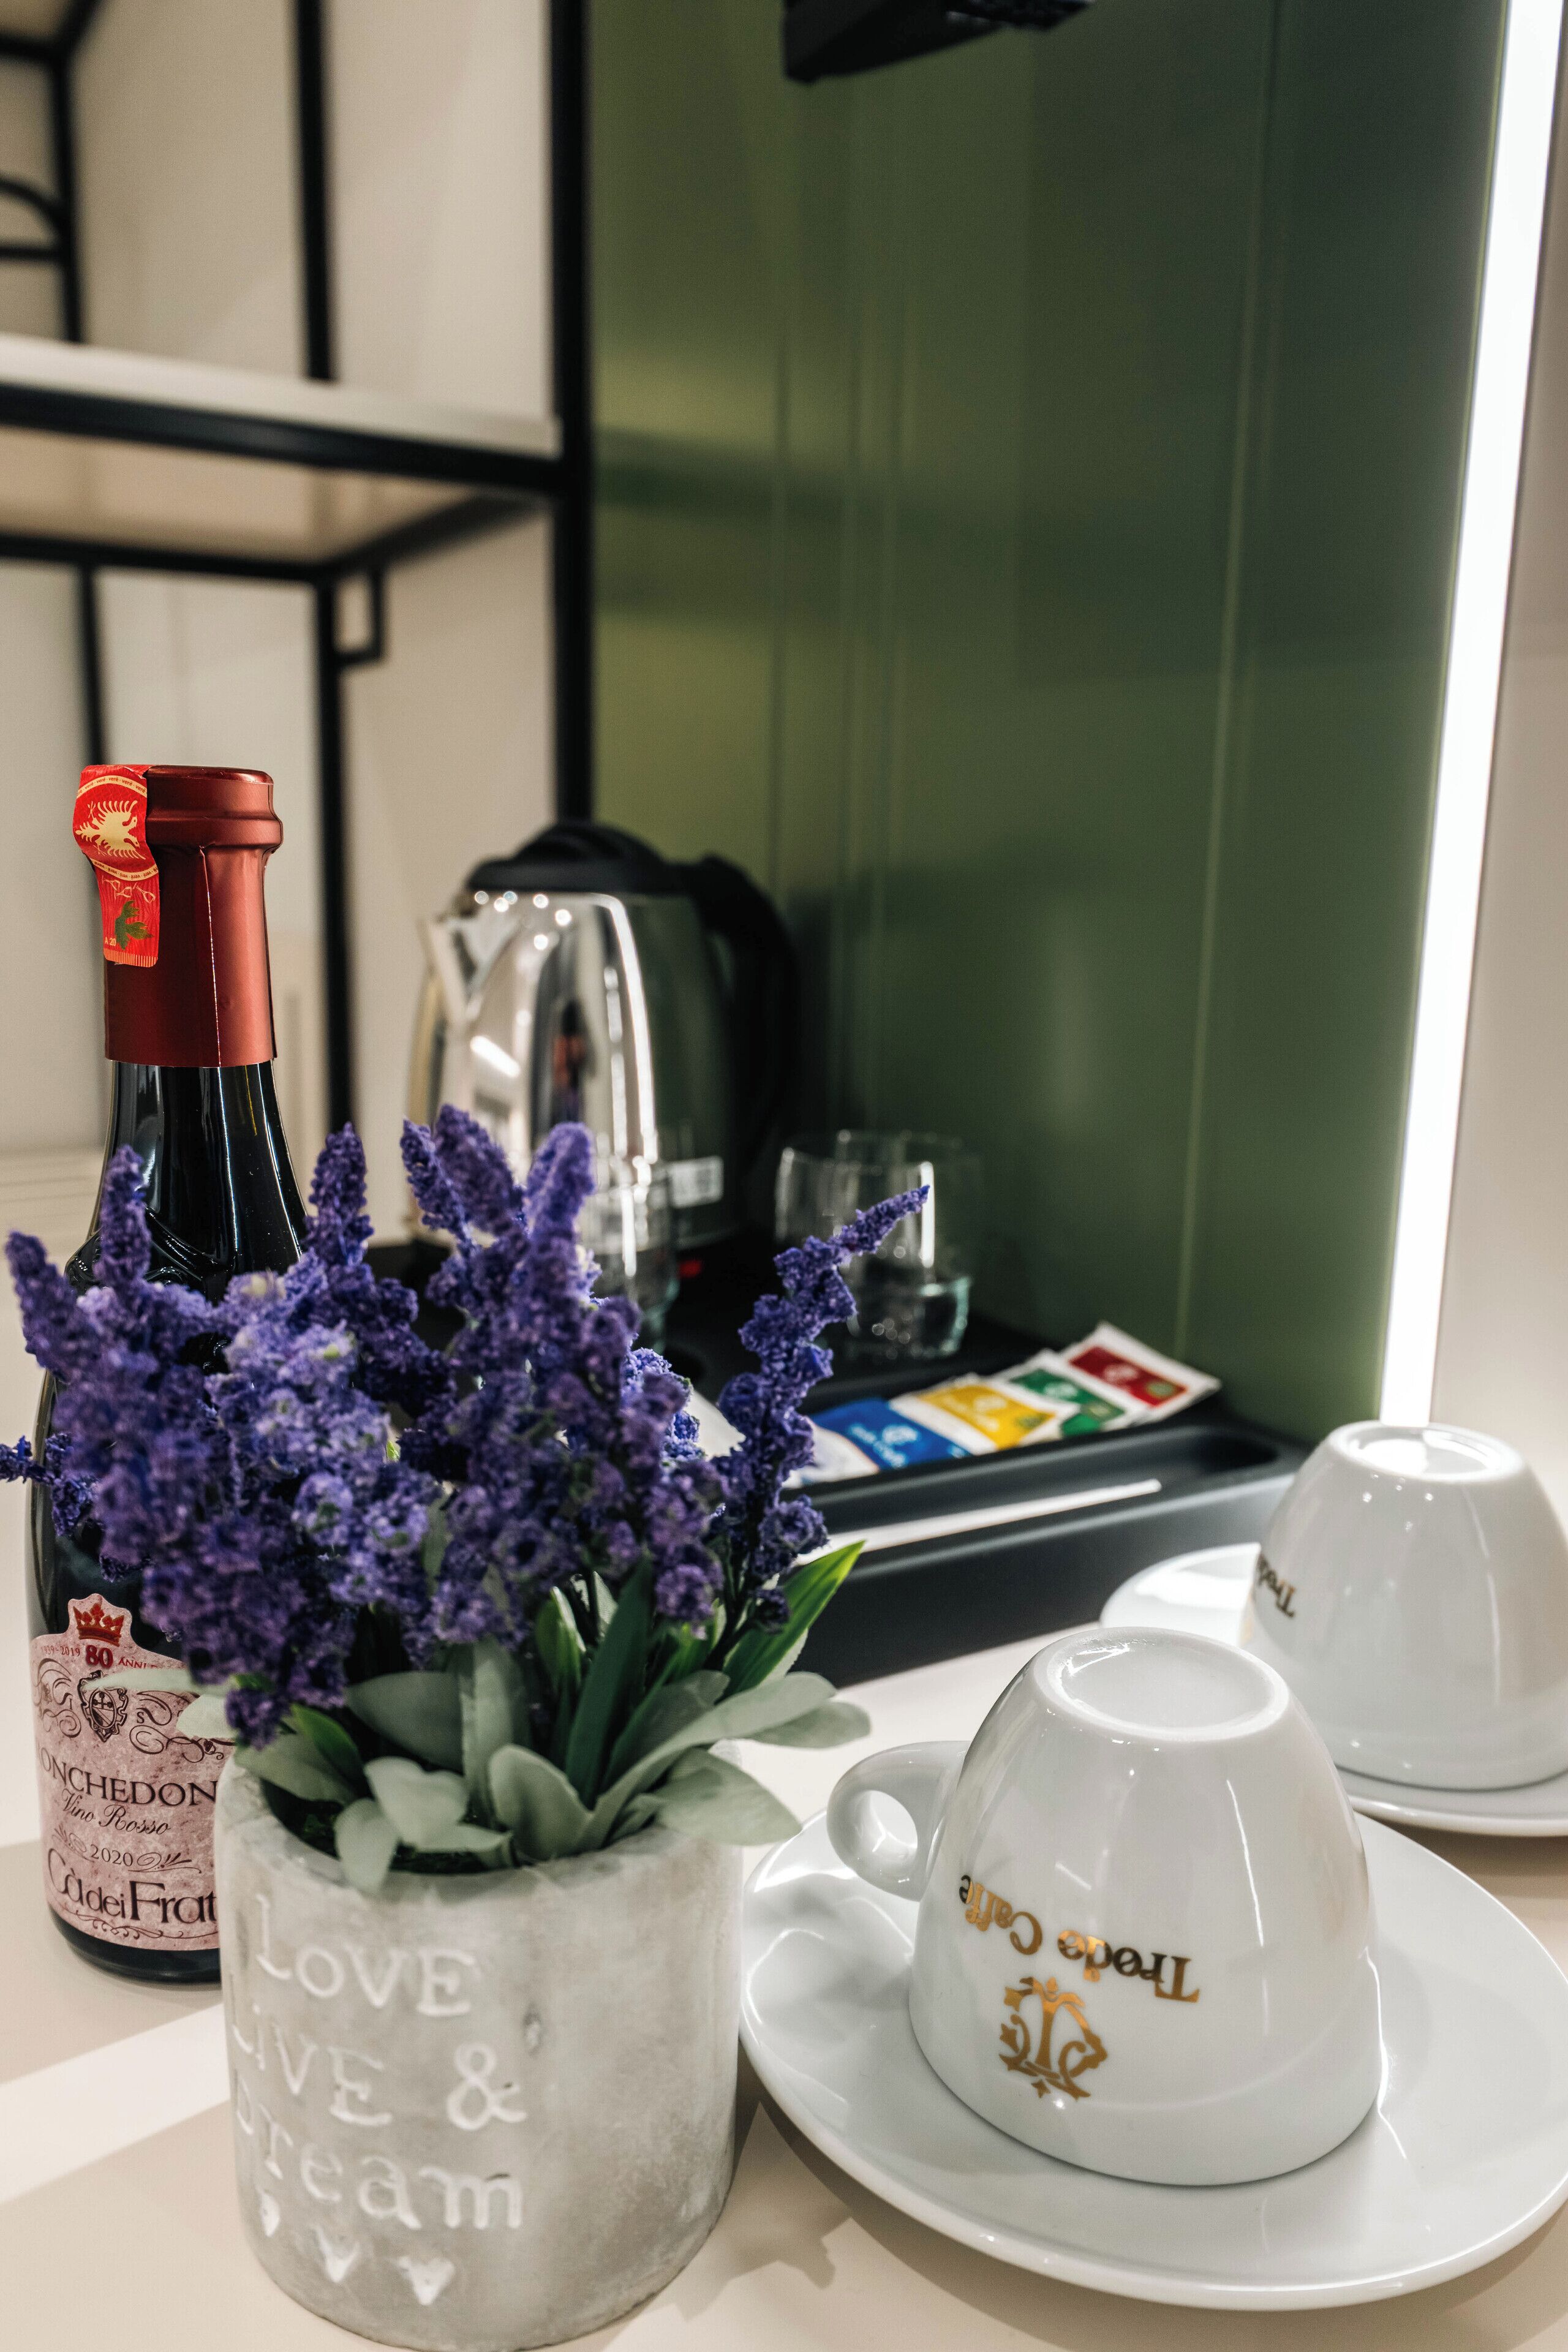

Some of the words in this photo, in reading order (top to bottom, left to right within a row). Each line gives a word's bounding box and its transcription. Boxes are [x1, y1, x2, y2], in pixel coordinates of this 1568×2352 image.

[85, 1644, 113, 1669] 80
[62, 1788, 95, 1823] Vino
[98, 1804, 171, 1835] Rosso
[91, 1844, 134, 1867] 2020
[255, 1892, 483, 2016] LOVE
[446, 2042, 529, 2131] &
